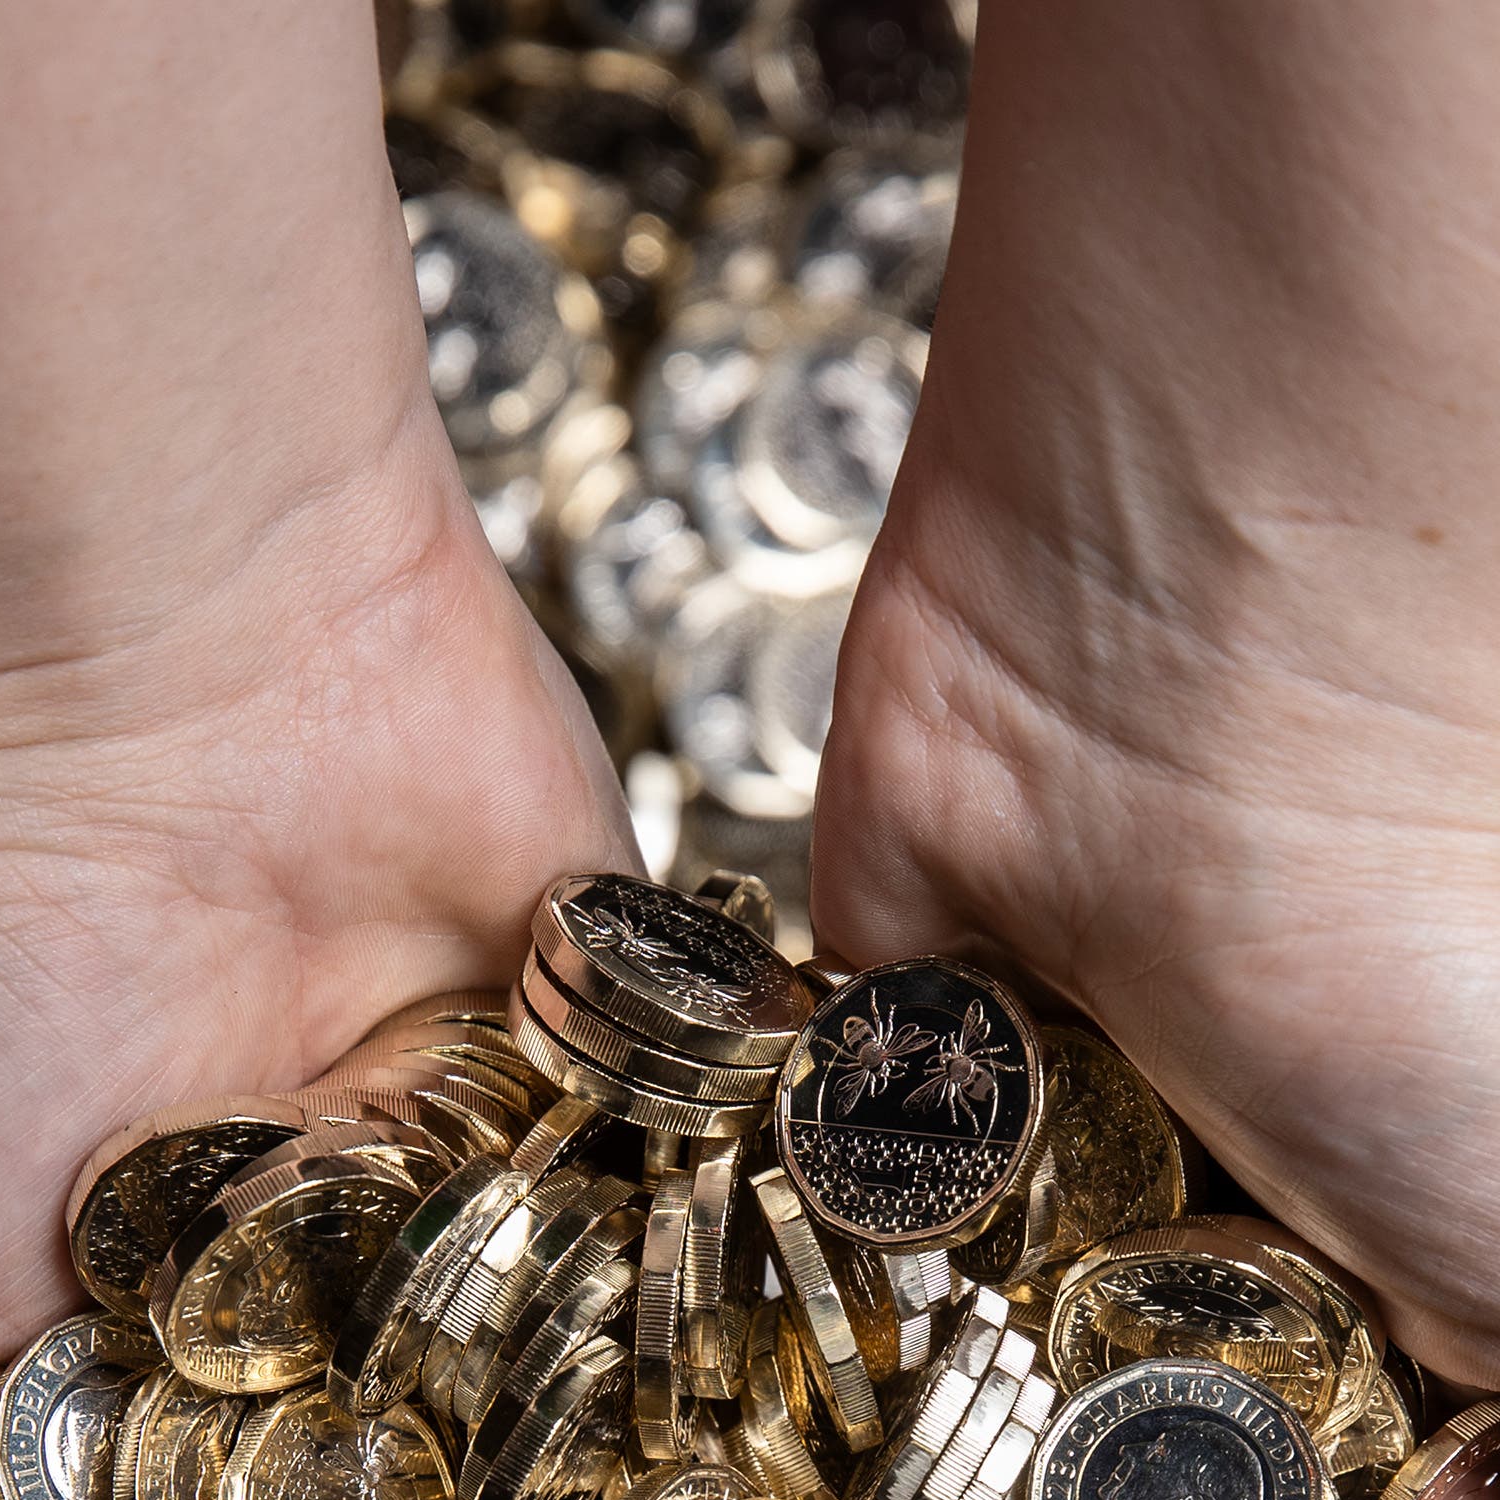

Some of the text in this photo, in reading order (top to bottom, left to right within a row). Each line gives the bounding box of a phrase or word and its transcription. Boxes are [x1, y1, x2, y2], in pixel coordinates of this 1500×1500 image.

[904, 1141, 937, 1227] POUND
[1125, 1262, 1197, 1289] REX
[1207, 1267, 1228, 1290] F
[1236, 1279, 1263, 1304] D
[43, 1326, 108, 1376] GRA
[11, 1374, 53, 1441] DEI
[1069, 1376, 1227, 1449] CHARLES
[1229, 1397, 1274, 1442] III
[1267, 1442, 1307, 1497] DEI
[10, 1452, 44, 1497] III
